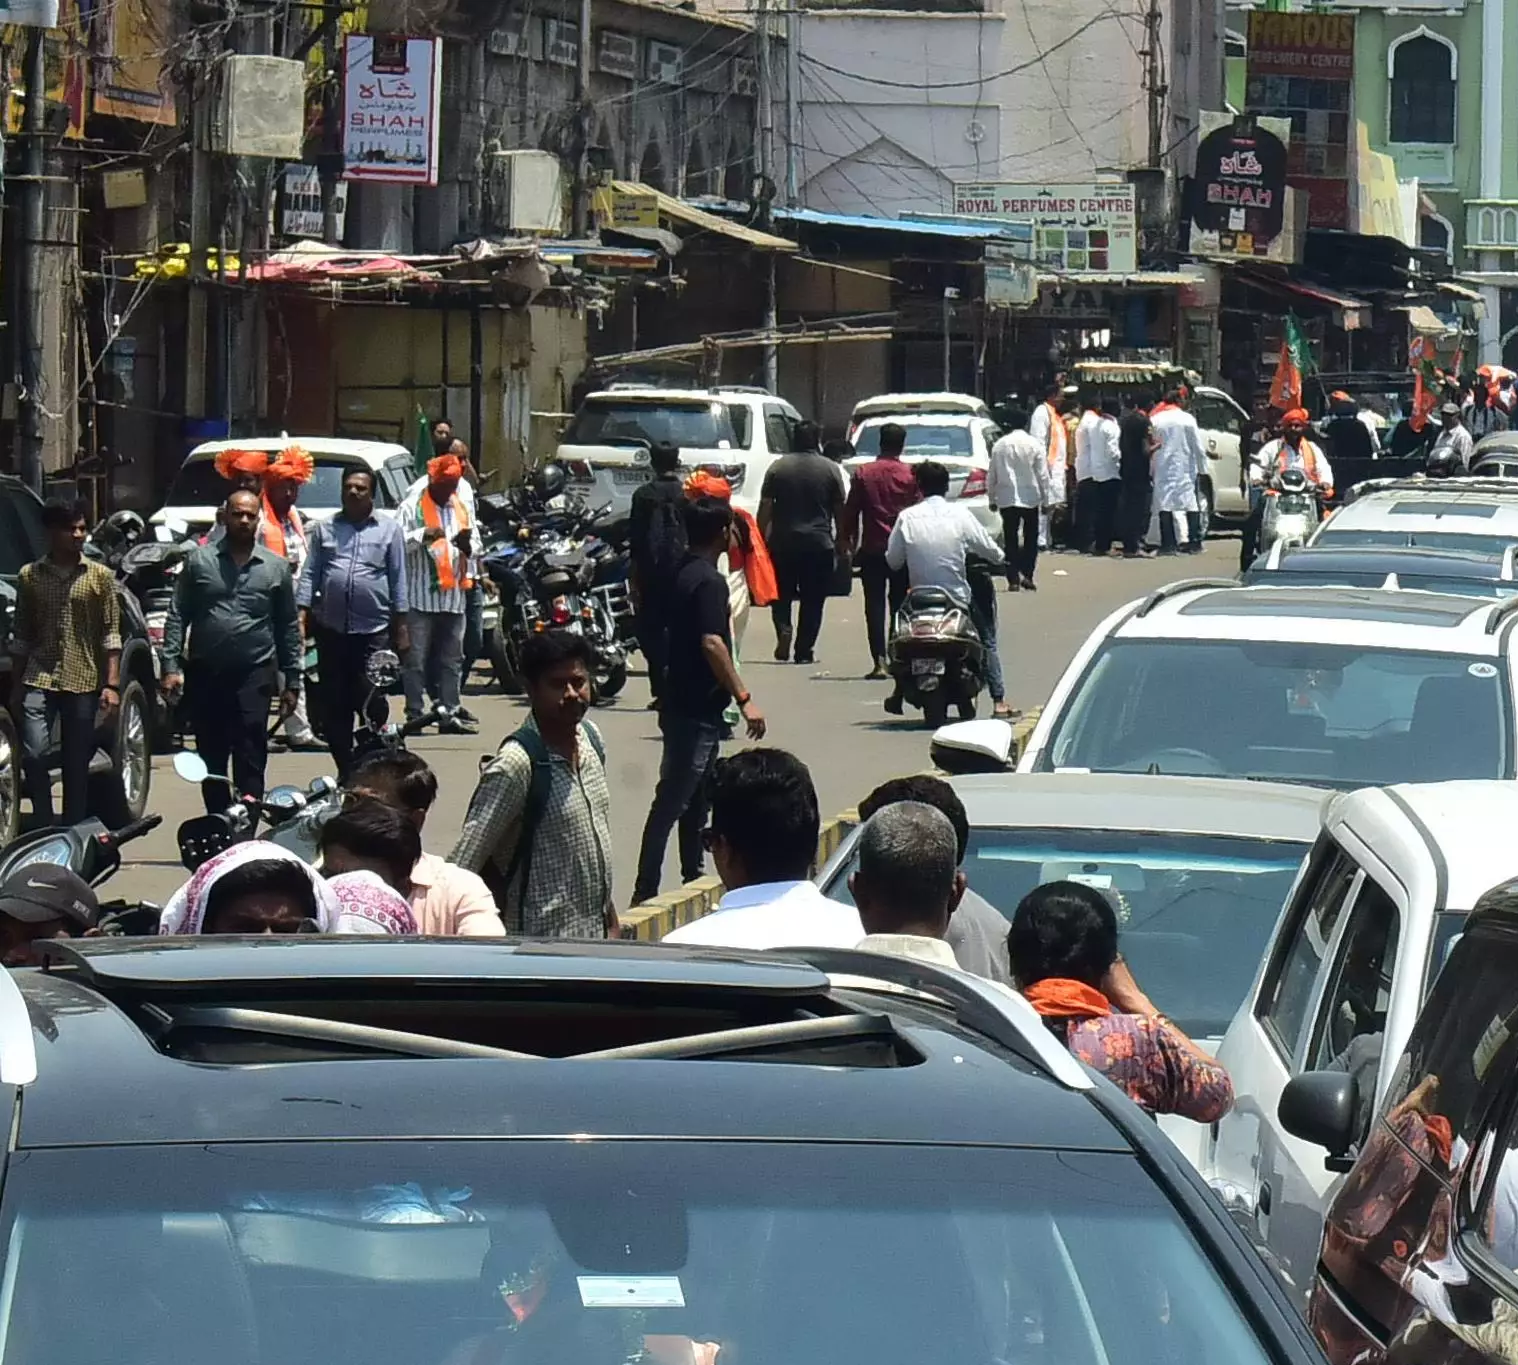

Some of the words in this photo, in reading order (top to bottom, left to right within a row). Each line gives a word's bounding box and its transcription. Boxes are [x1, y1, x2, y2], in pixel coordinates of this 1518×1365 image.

[1251, 11, 1354, 49] FAMOUS
[1311, 54, 1352, 68] CENTRE
[350, 112, 425, 128] SHAH
[1207, 182, 1273, 208] SHAH
[957, 198, 998, 213] ROYAL
[1002, 198, 1076, 213] PERFUMES
[1079, 198, 1133, 213] CENTRE
